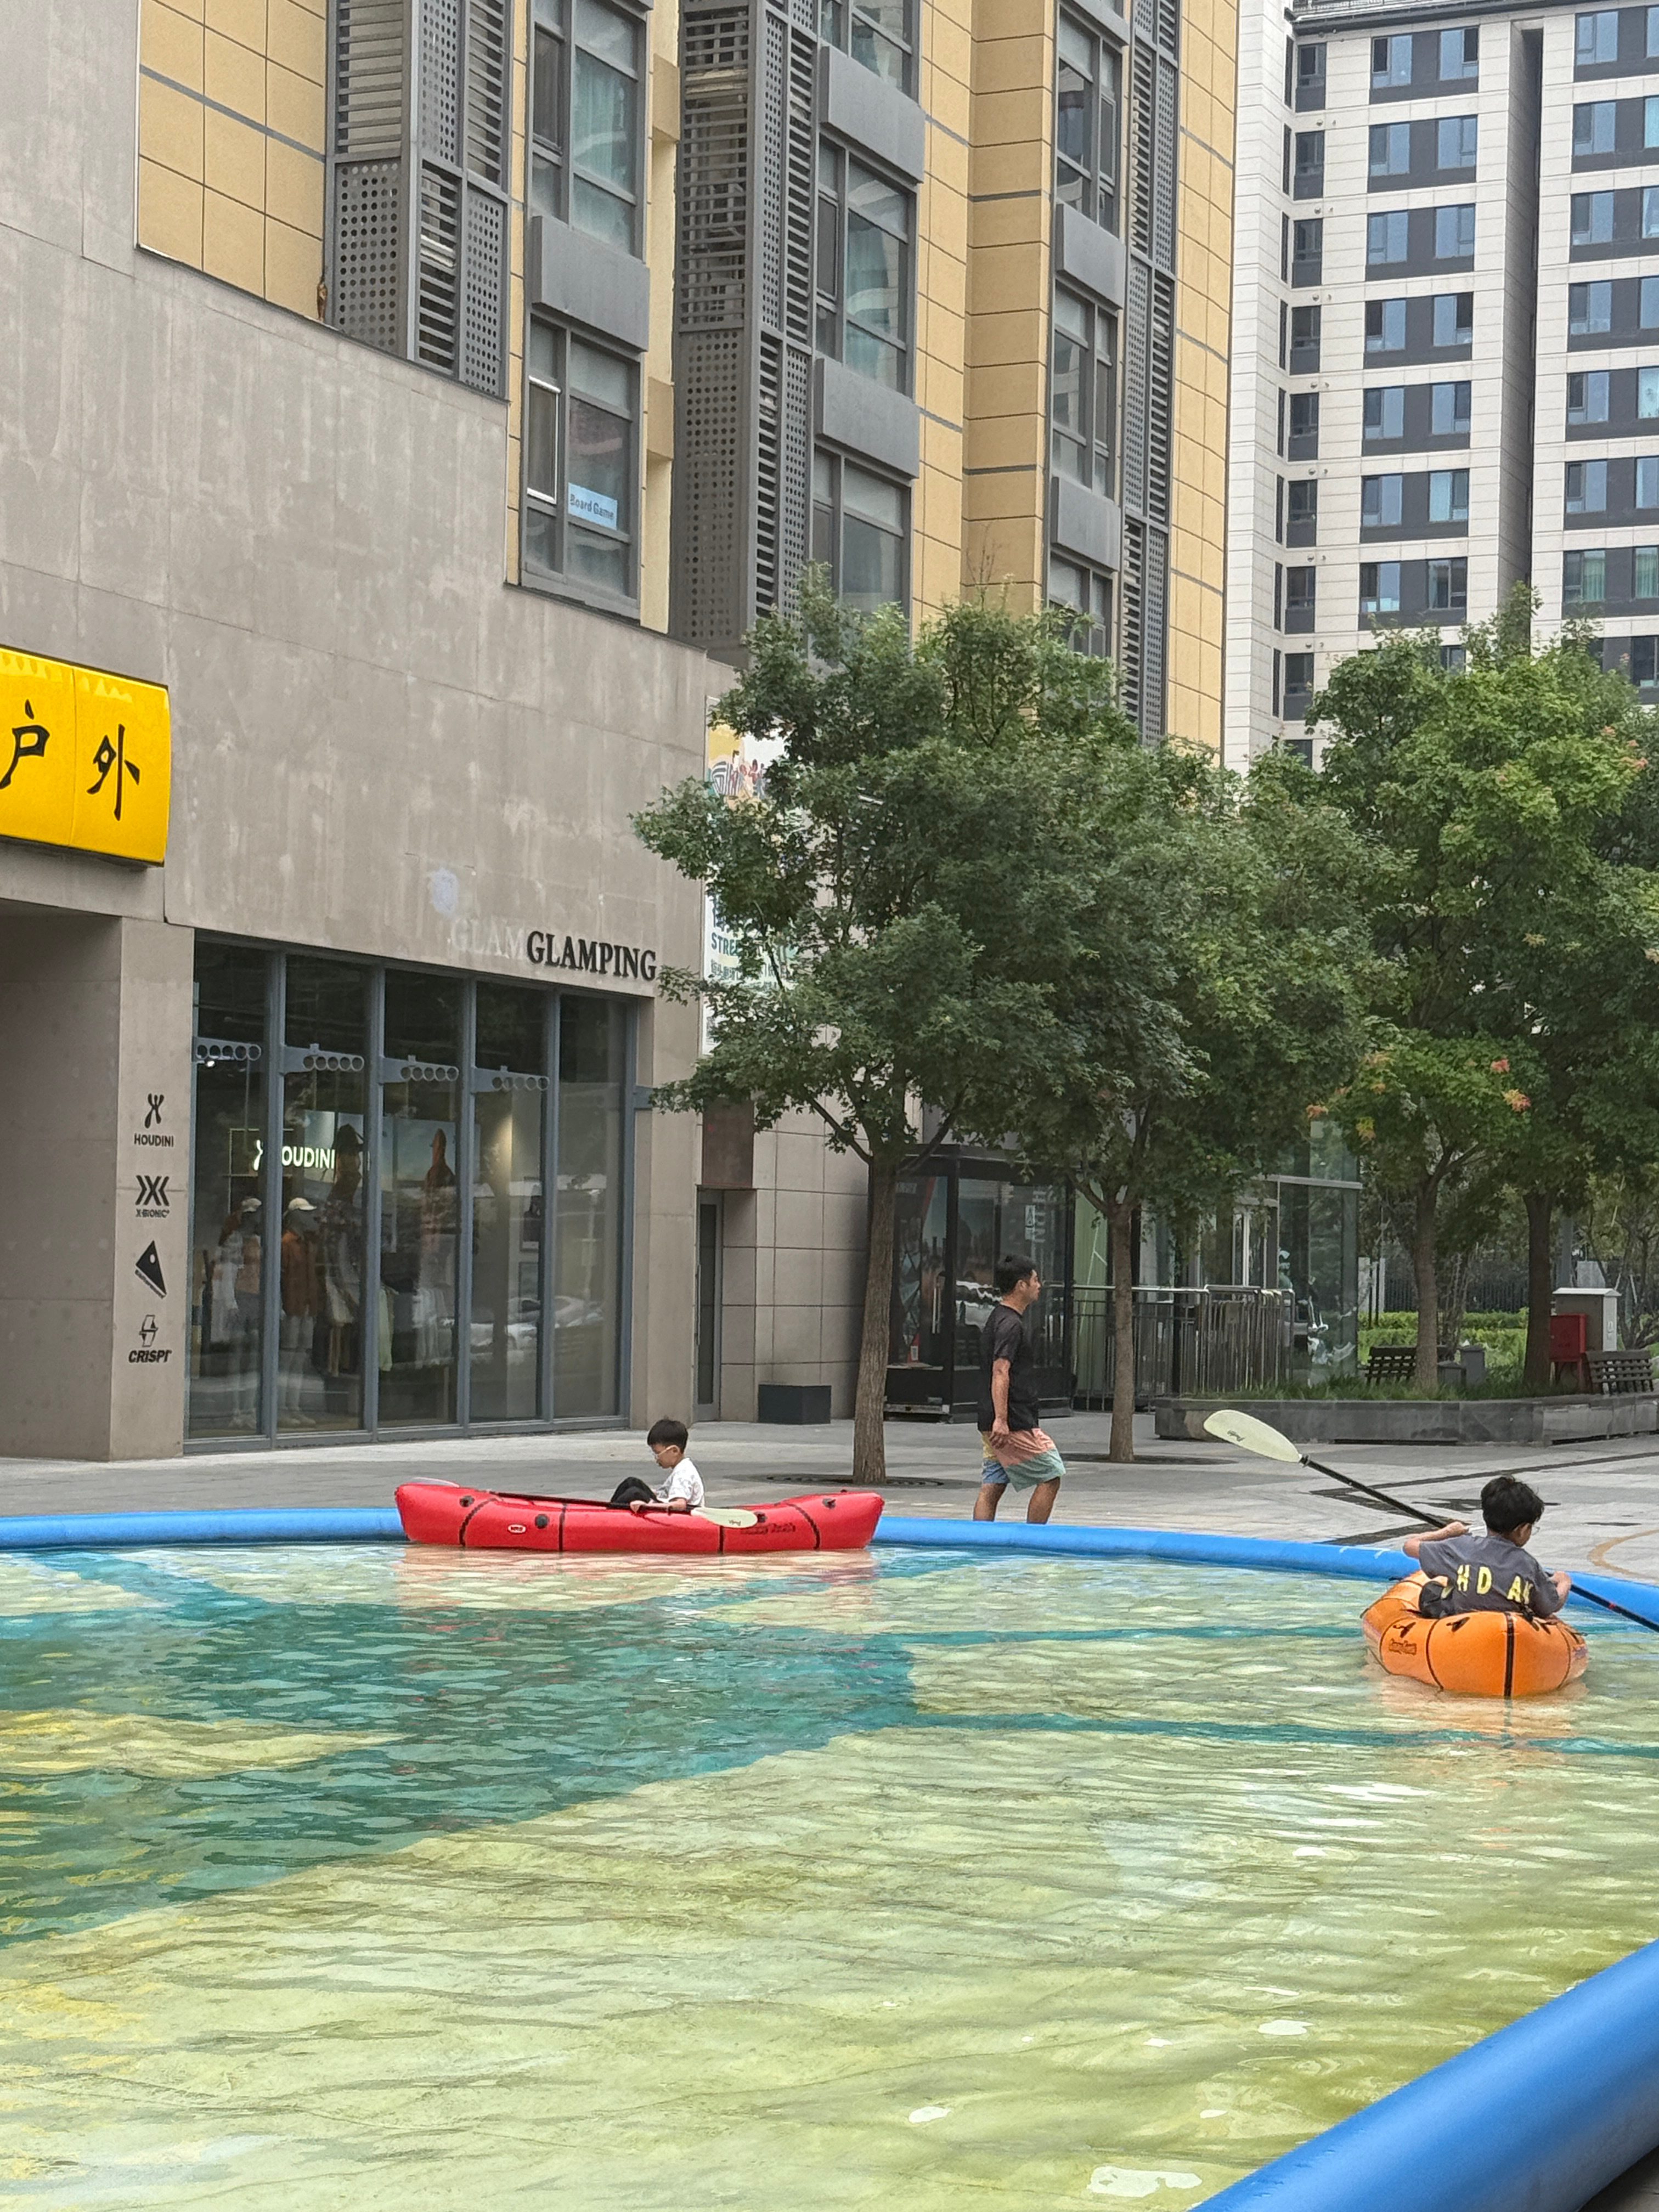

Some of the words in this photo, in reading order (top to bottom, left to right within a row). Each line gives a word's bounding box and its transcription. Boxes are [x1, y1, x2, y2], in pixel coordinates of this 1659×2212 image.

[570, 493, 592, 512] Board
[0, 699, 140, 821] 户外
[527, 930, 657, 981] GLAMPING
[134, 1132, 174, 1148] HOUDINI
[281, 1146, 336, 1169] OUDINI
[128, 1350, 171, 1363] CRISPI
